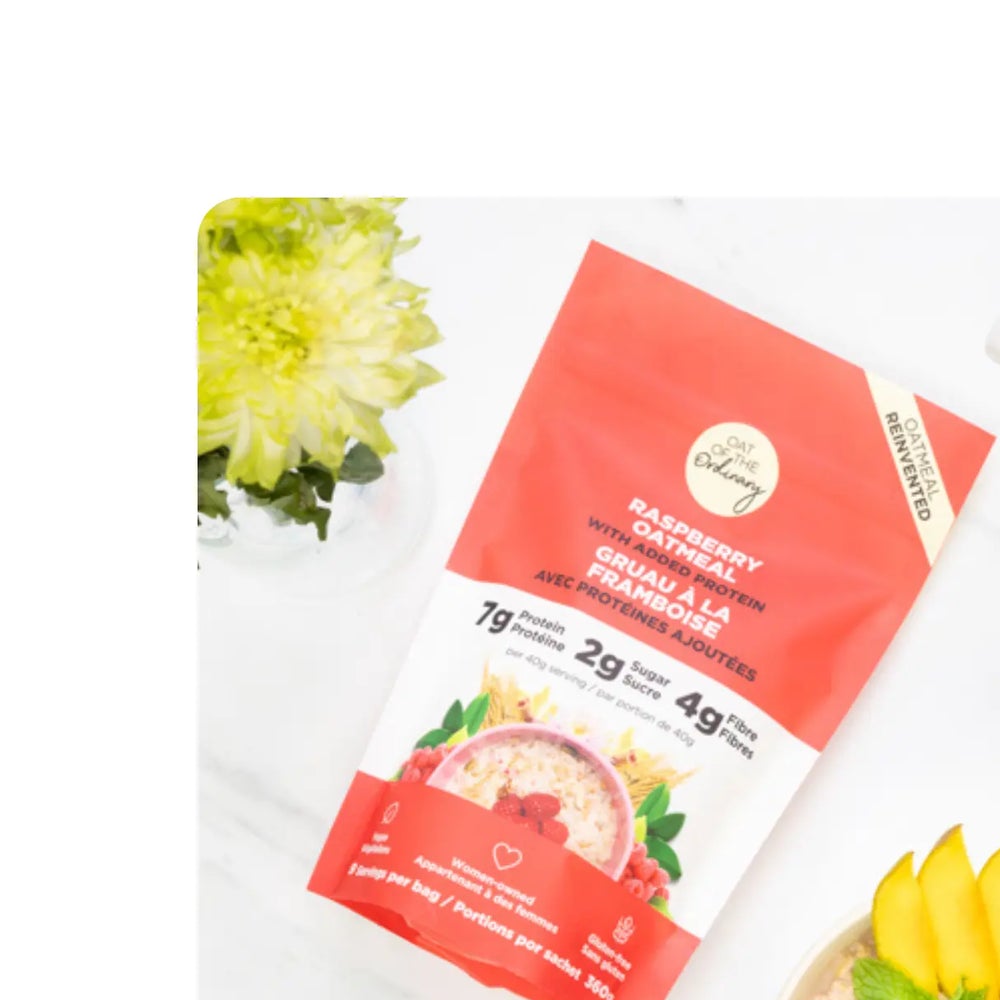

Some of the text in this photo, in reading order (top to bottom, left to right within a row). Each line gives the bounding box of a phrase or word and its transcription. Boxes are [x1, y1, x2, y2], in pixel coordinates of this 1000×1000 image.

[710, 443, 761, 474] OF THE
[726, 436, 756, 454] OAT
[885, 411, 932, 521] REINVENTED
[904, 418, 940, 501] OATMEAL
[694, 451, 766, 515] Ordinary
[628, 497, 764, 572] RASPBERRY
[632, 520, 736, 584] OATMEAL
[588, 516, 767, 614] WITH ADDED PROTEIN
[595, 546, 730, 624] GRUAU À LA
[475, 600, 514, 634] 7g
[518, 610, 566, 636] Protein
[534, 570, 758, 683] AVEC PROTÉINES AJOUTÉES
[586, 562, 722, 640] FRAMBOISE
[510, 622, 566, 652] Protéine
[574, 638, 626, 682] 2g
[505, 648, 524, 660] per
[526, 652, 547, 671] 40g
[548, 665, 588, 690] serving
[596, 688, 616, 703] par
[615, 698, 656, 724] portion
[656, 718, 672, 732] de
[672, 728, 696, 748] 40g
[622, 674, 662, 700] Sucre
[630, 660, 671, 688] Sugar
[674, 690, 725, 736] 4g
[726, 712, 758, 742] Fibre
[718, 727, 754, 760] Fibres
[413, 854, 484, 895] Appartenant
[492, 894, 514, 911] des
[515, 904, 560, 935] femmes
[451, 856, 536, 906] Women-owned
[386, 871, 412, 888] per
[410, 879, 441, 904] bag
[438, 894, 455, 908] /
[453, 900, 515, 940] Portions
[543, 949, 582, 981] sachet
